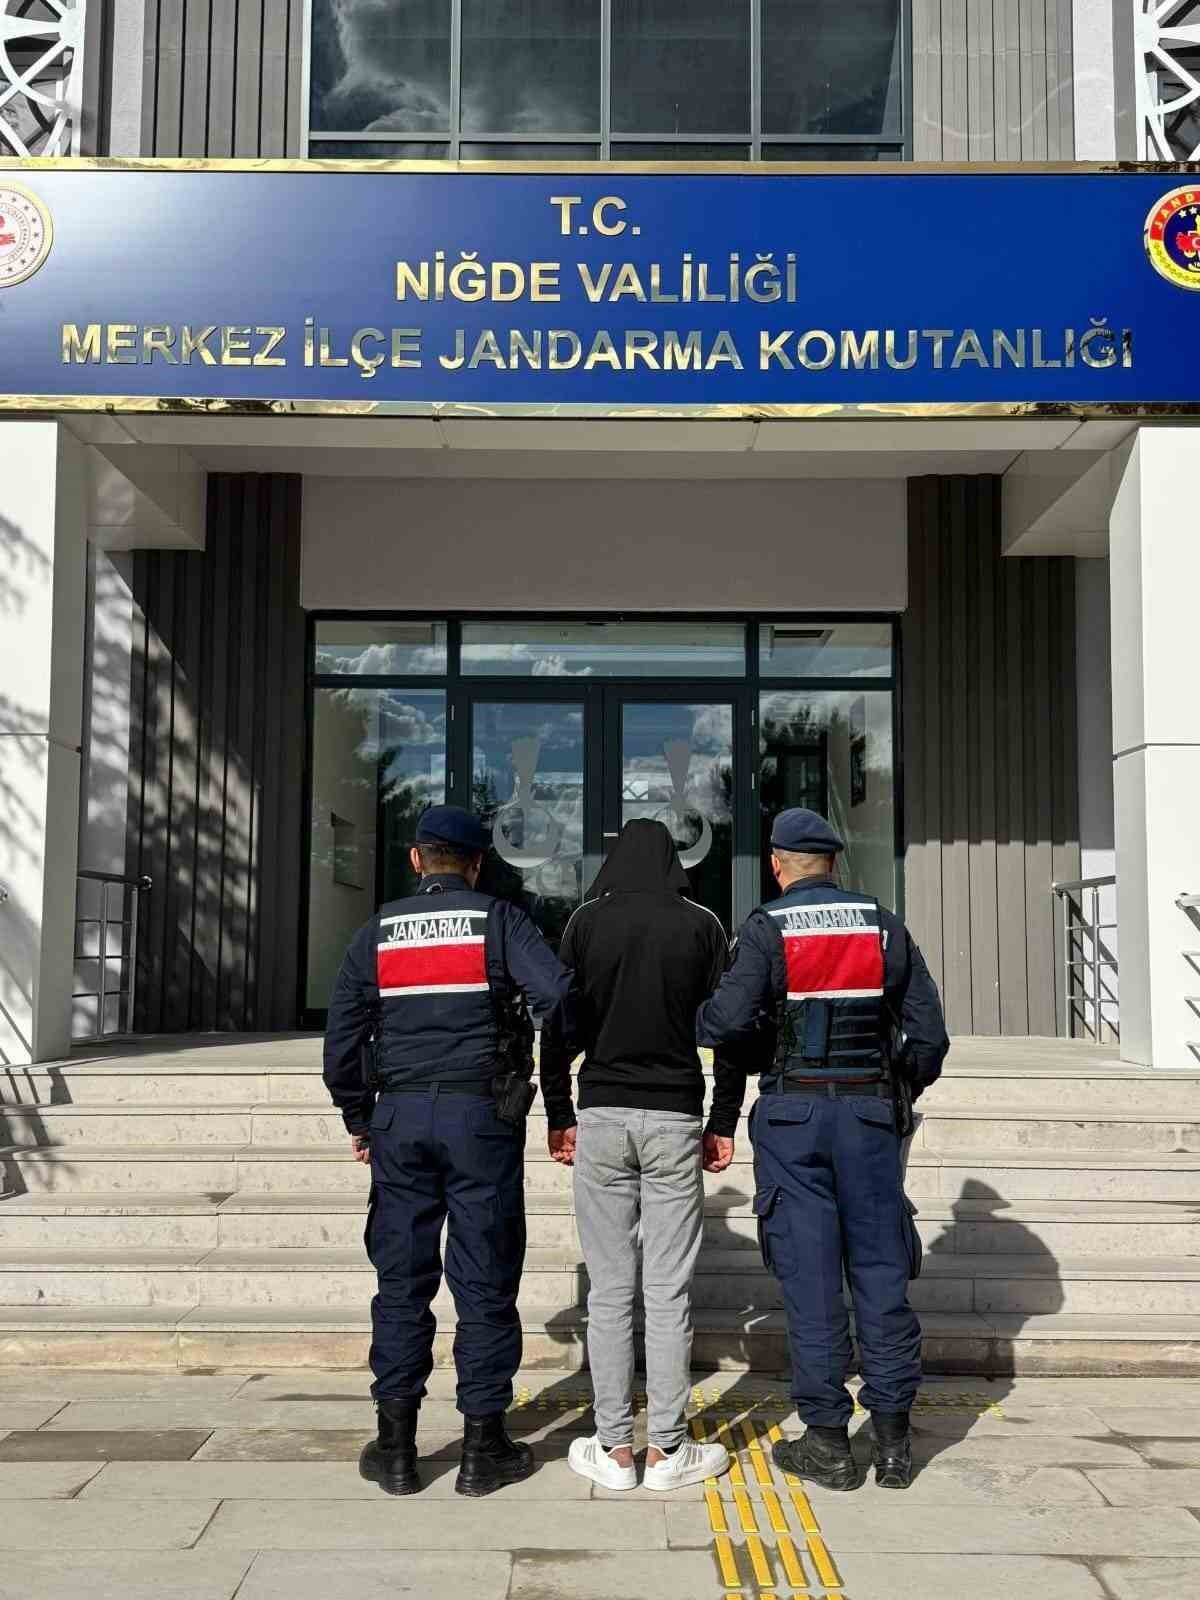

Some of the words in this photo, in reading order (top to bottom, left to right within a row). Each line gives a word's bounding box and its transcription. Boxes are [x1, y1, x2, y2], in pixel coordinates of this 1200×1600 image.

[550, 196, 641, 236] T.C.
[396, 251, 561, 302] NİĞDE
[577, 253, 797, 303] VALİLİĞİ
[62, 323, 286, 366] MERKEZ
[304, 318, 422, 378] İLÇE
[439, 330, 743, 370] JANDARMA
[759, 317, 1133, 370] KOMUTANLIĞI
[387, 918, 473, 941] JANDARMA
[785, 910, 866, 929] JANDARMA
